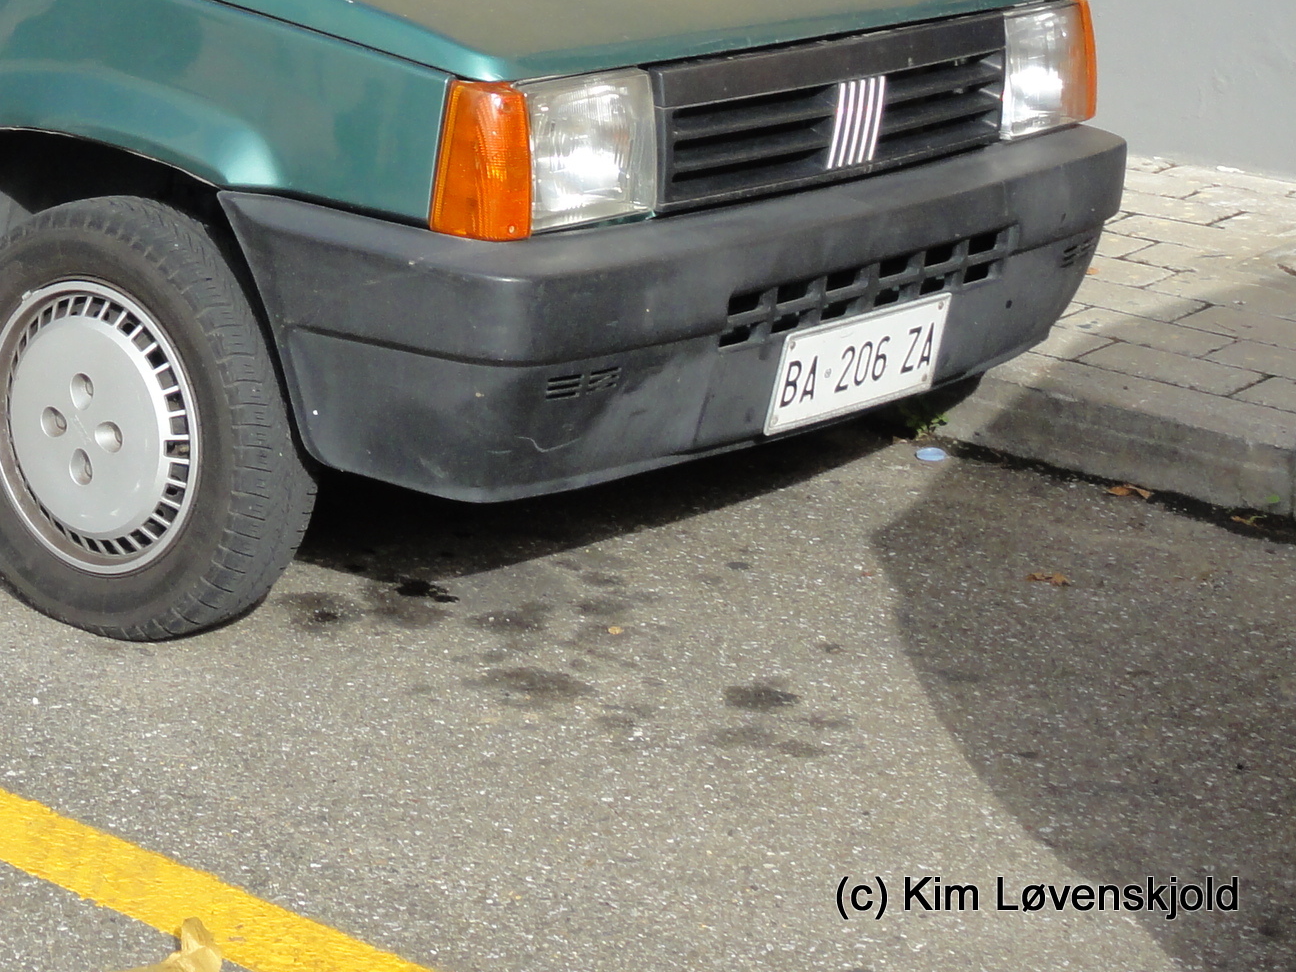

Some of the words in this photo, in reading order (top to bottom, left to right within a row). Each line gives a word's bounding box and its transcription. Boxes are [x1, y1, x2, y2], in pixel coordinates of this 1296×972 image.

[779, 355, 818, 408] BA
[833, 335, 892, 394] 206
[900, 322, 936, 375] ZA
